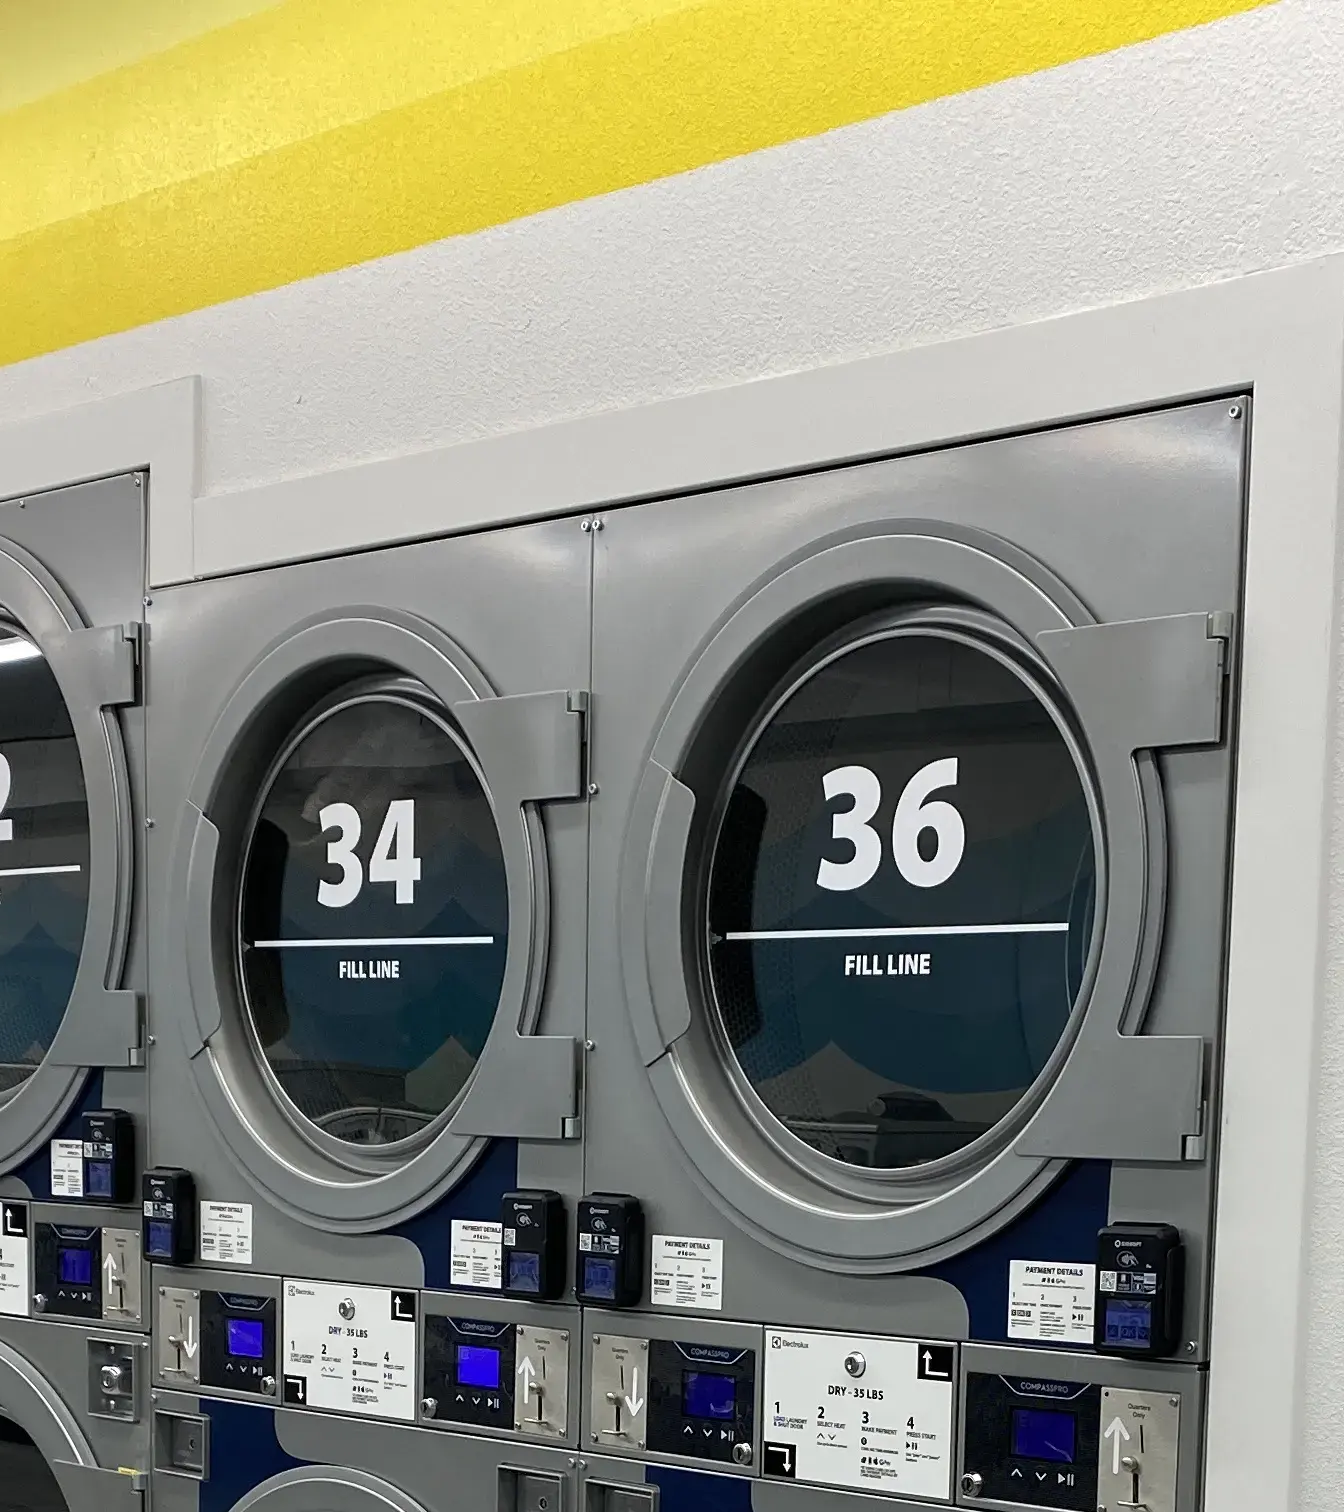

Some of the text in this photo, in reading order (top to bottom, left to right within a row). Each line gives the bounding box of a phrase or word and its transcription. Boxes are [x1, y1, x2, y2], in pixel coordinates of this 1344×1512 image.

[816, 757, 965, 891] 36
[317, 799, 422, 908] 34
[339, 960, 399, 979] FILL LINE
[844, 952, 931, 976] FILL LINE
[1025, 1266, 1083, 1276] PAYMENT DETAILS
[328, 1326, 341, 1335] DRY
[346, 1328, 354, 1337] 35
[356, 1329, 368, 1338] LBS
[783, 1339, 809, 1349] Electrolux
[690, 1347, 730, 1359] COMPASSPRO
[827, 1385, 846, 1396] DRY
[854, 1387, 864, 1398] 35
[866, 1389, 883, 1400] LBS
[1020, 1382, 1069, 1393] COMPASSPRO
